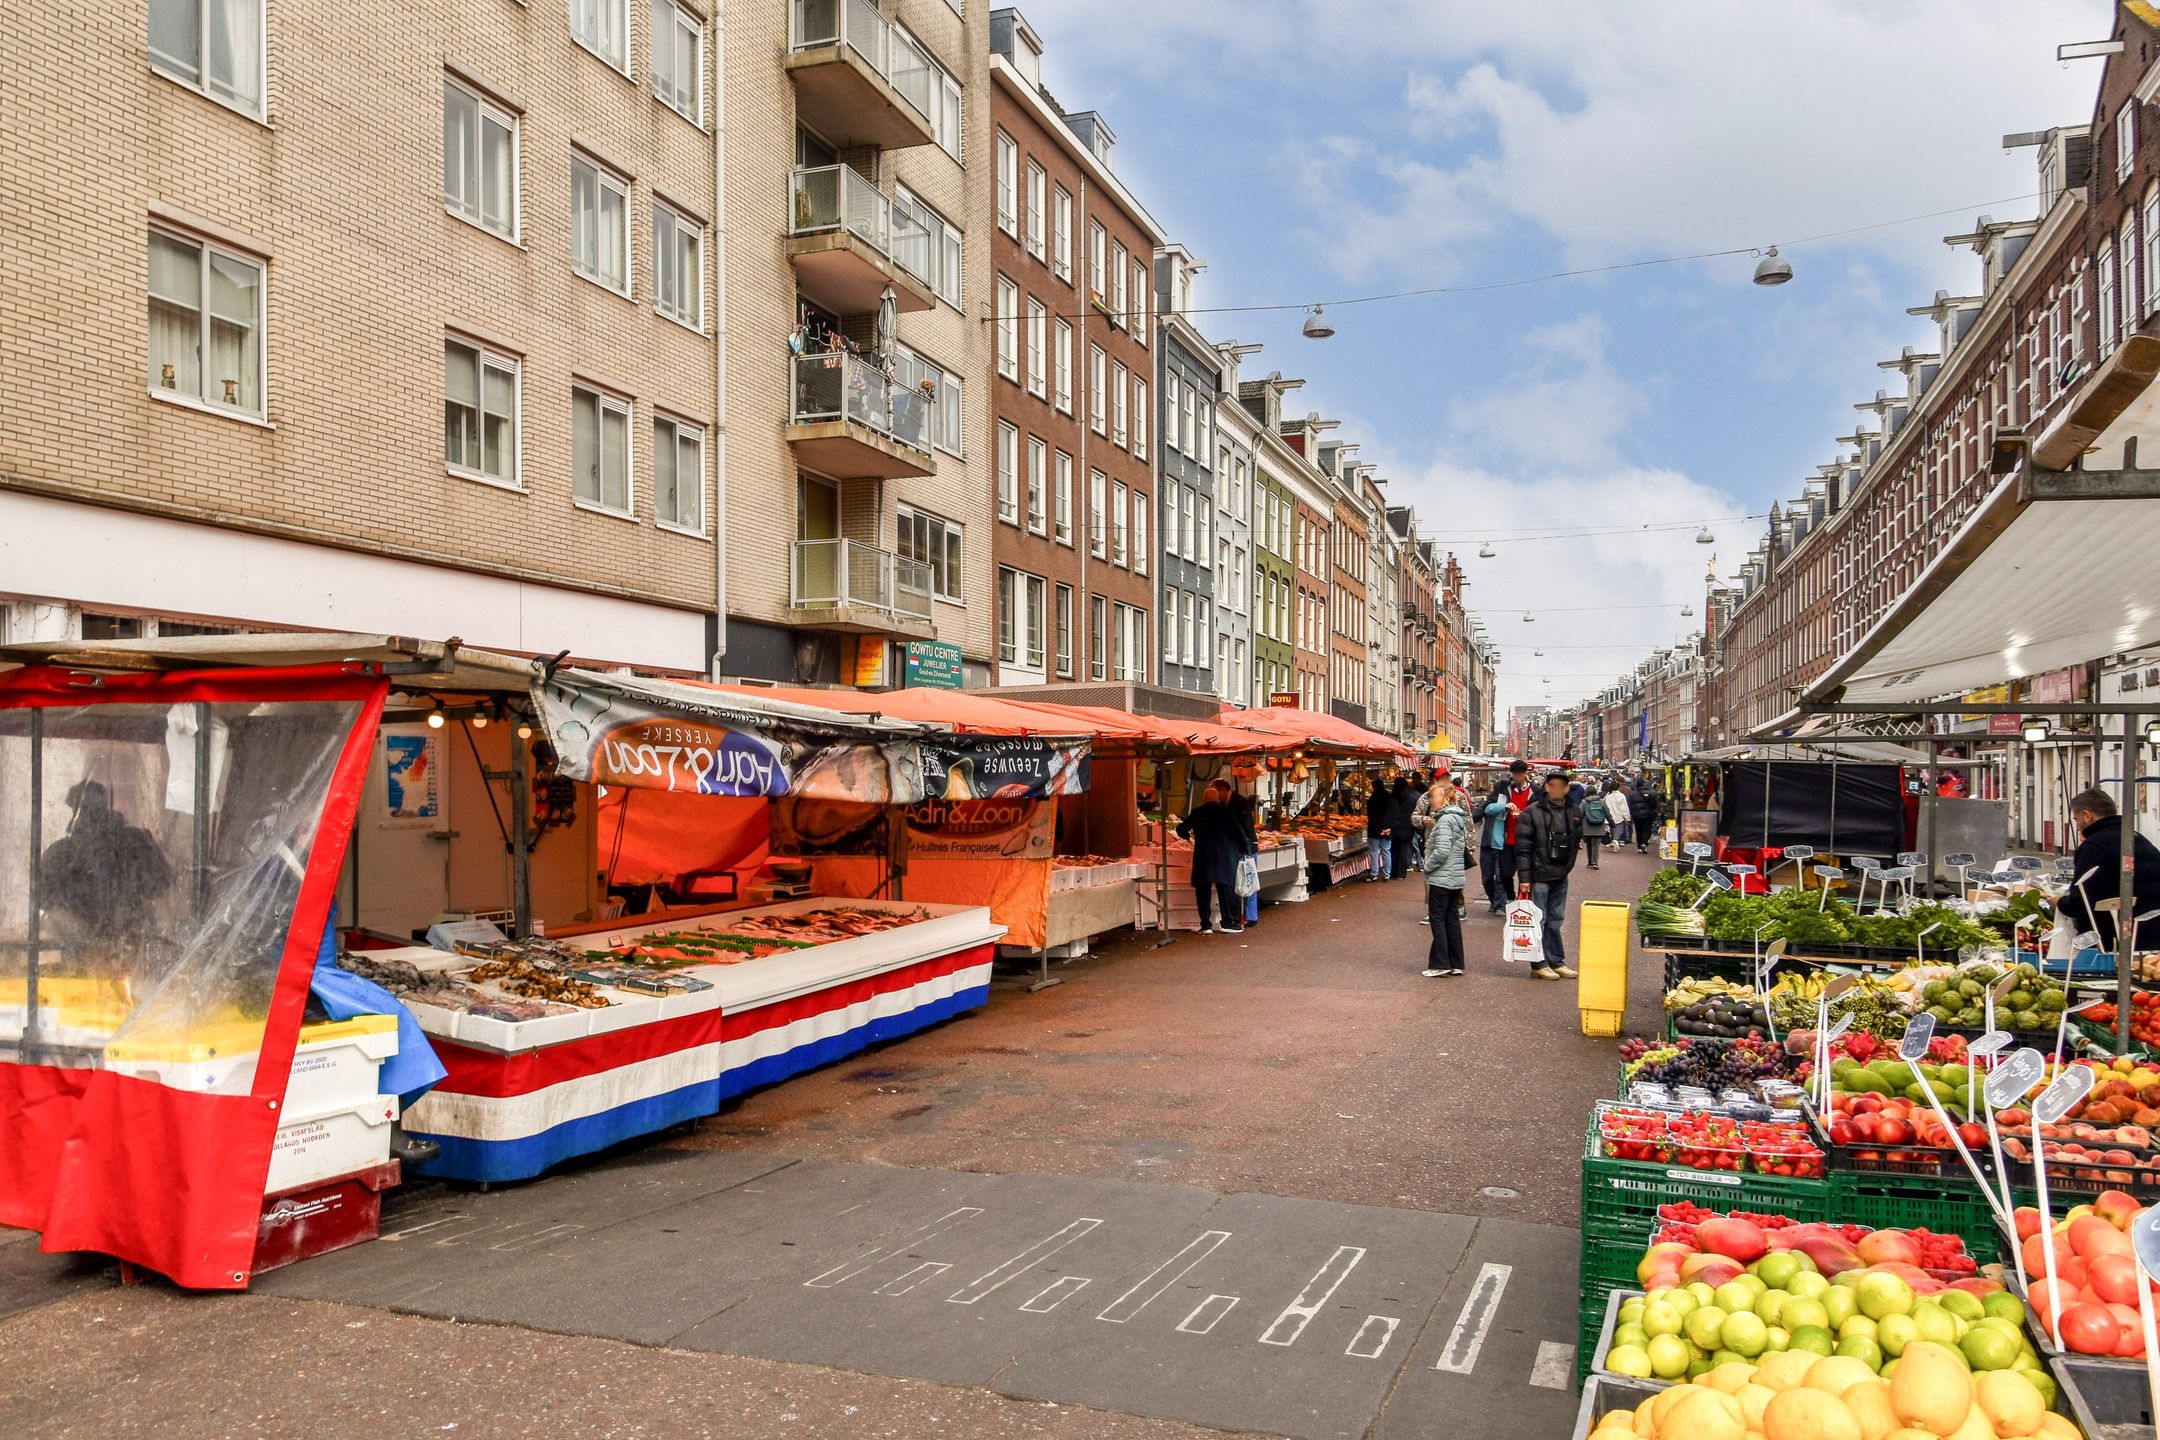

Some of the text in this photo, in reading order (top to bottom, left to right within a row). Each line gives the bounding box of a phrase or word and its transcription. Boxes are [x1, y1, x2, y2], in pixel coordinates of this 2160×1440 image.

[910, 641, 959, 662] GOWTU CENTRE
[641, 726, 713, 745] YERSEKE
[983, 757, 1042, 778] Zeeuwse
[950, 841, 1001, 855] Françaises
